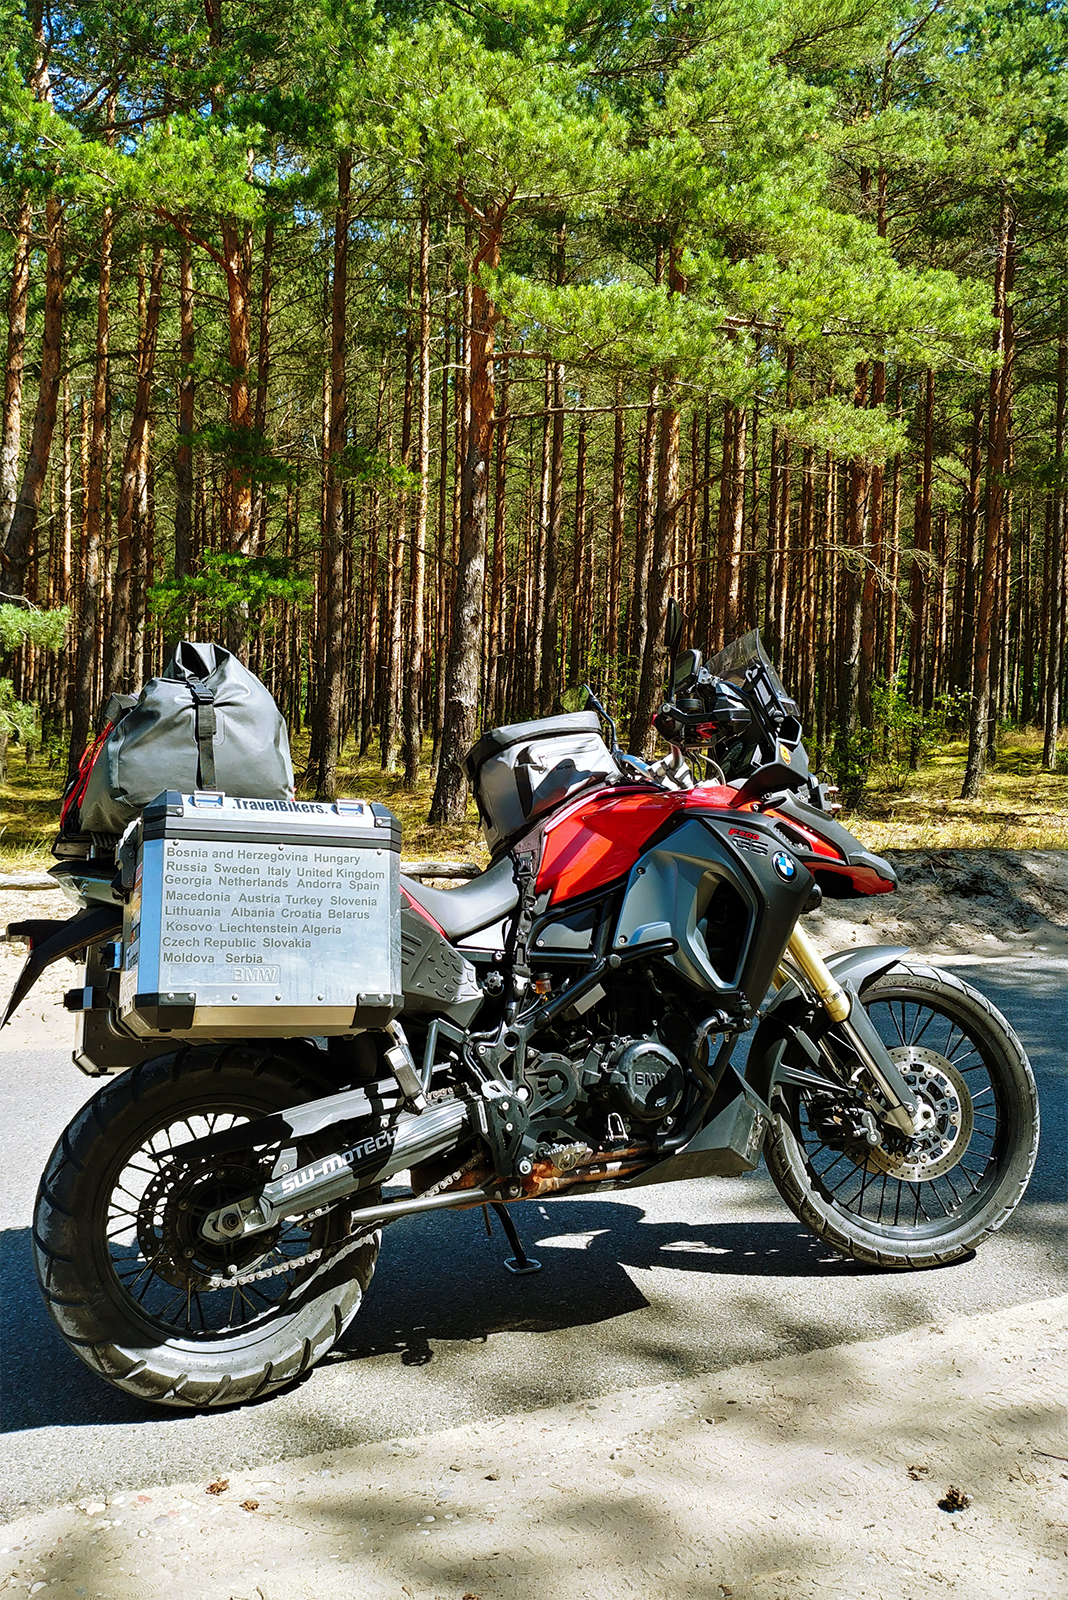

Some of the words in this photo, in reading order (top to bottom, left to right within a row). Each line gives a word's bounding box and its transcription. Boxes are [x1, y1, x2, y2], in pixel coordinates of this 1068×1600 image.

[728, 828, 760, 840] F800
[166, 847, 209, 858] Bosnia
[211, 849, 234, 859] and
[237, 849, 308, 862] Herzegovina
[314, 853, 361, 865] Hungary
[166, 861, 207, 872] Russia
[213, 863, 260, 874] Sweden
[267, 866, 291, 878] Italy
[296, 867, 333, 877] United
[336, 868, 385, 880] Kingdom
[164, 874, 212, 887] Georgia
[218, 876, 289, 888] Netherlands
[296, 878, 342, 889] Andorra
[349, 880, 380, 892] Spain
[165, 890, 231, 901] Macedonia
[238, 893, 280, 903] Austria
[285, 894, 323, 907] Turkey
[330, 895, 378, 906] Slovenia
[165, 905, 221, 916] Lithuania
[230, 907, 275, 917] Albania
[281, 908, 322, 919] Croatia
[328, 909, 370, 919] Belarus
[166, 921, 213, 932] Kosovo
[219, 922, 298, 933] Liechtenstein
[301, 924, 342, 936] Algeria
[162, 936, 200, 947] Czech
[204, 937, 257, 950] Republic
[262, 937, 312, 948] Slovakia
[163, 952, 215, 963] Moldova
[225, 953, 263, 963] Serbia
[232, 967, 277, 982] BMW
[281, 1130, 396, 1195] SW-MOTECH
